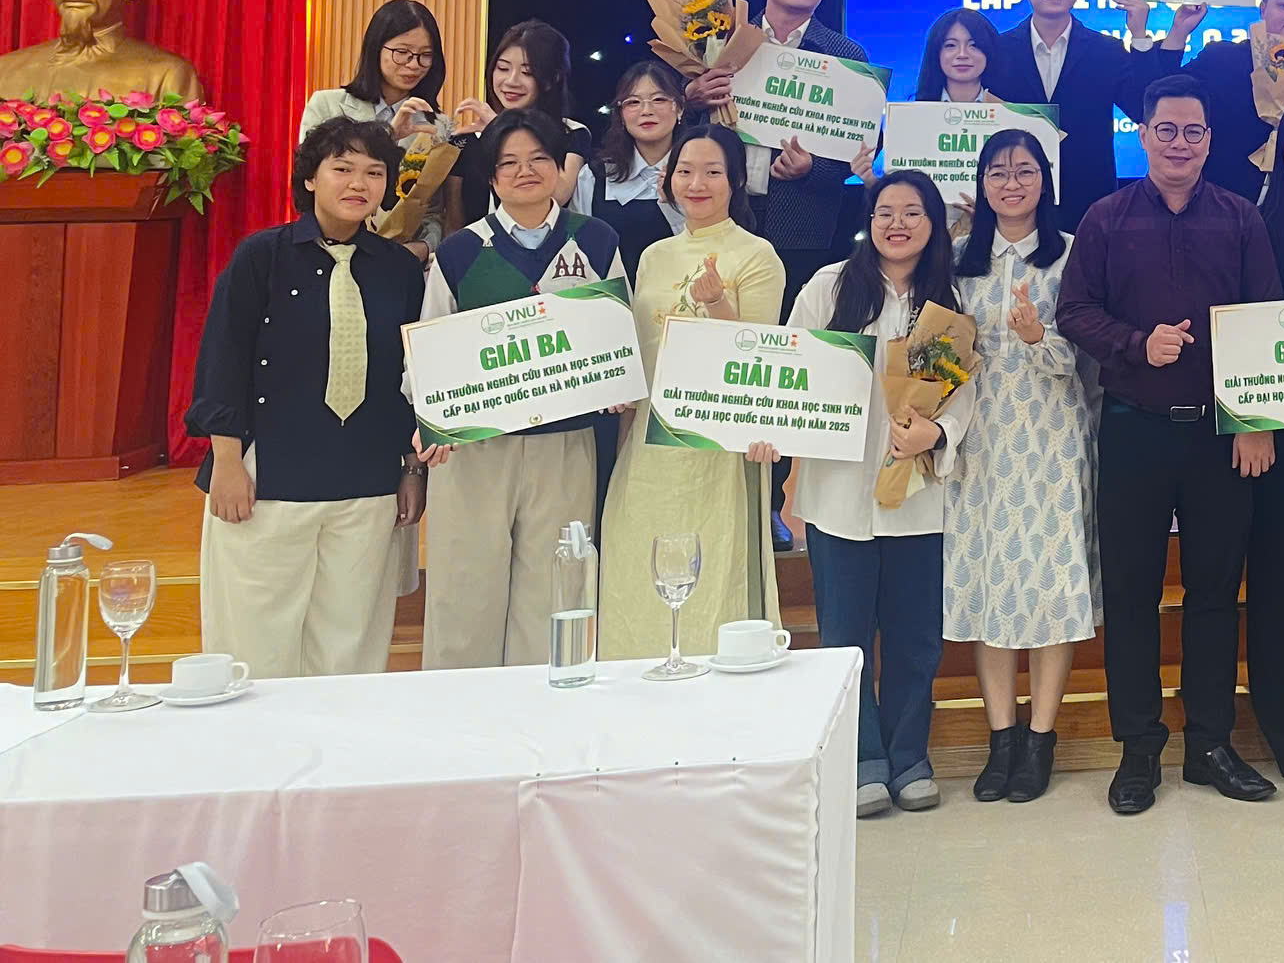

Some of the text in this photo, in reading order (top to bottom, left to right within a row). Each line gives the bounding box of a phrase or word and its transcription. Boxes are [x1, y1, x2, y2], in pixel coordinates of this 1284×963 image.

[798, 57, 821, 69] VNU
[766, 75, 833, 106] GIẢI BA
[964, 110, 988, 119] VNU
[938, 129, 977, 152] GIẢI
[506, 306, 536, 322] VNU
[480, 331, 571, 370] GIẢI BA
[761, 333, 789, 346] VNU
[426, 391, 445, 405] GIẢI
[487, 374, 520, 390] NGHIÊN
[522, 369, 541, 382] CỨU
[543, 364, 568, 376] KHOA
[570, 358, 589, 370] HỌC
[591, 353, 612, 365] SINH
[614, 346, 633, 359] VIÊN
[724, 357, 808, 391] GIẢI BA
[1225, 376, 1241, 388] GIẢI
[443, 366, 626, 418] CẤP ĐẠI HỌC QUỐC GIA HÀ NỘI NĂM 2025
[664, 387, 682, 399] GIẢI
[722, 394, 753, 406] NGHIÊN
[756, 396, 774, 408] CỨU
[776, 400, 799, 410] KHOA
[802, 402, 820, 413] HỌC
[822, 404, 842, 414] SINH
[845, 404, 862, 415] VIÊN
[1238, 392, 1254, 404] CẤP
[1257, 393, 1270, 404] ĐẠI
[675, 406, 850, 432] CẤP ĐẠI HỌC QUỐC GIA HÀ NỘI NĂM 2025
